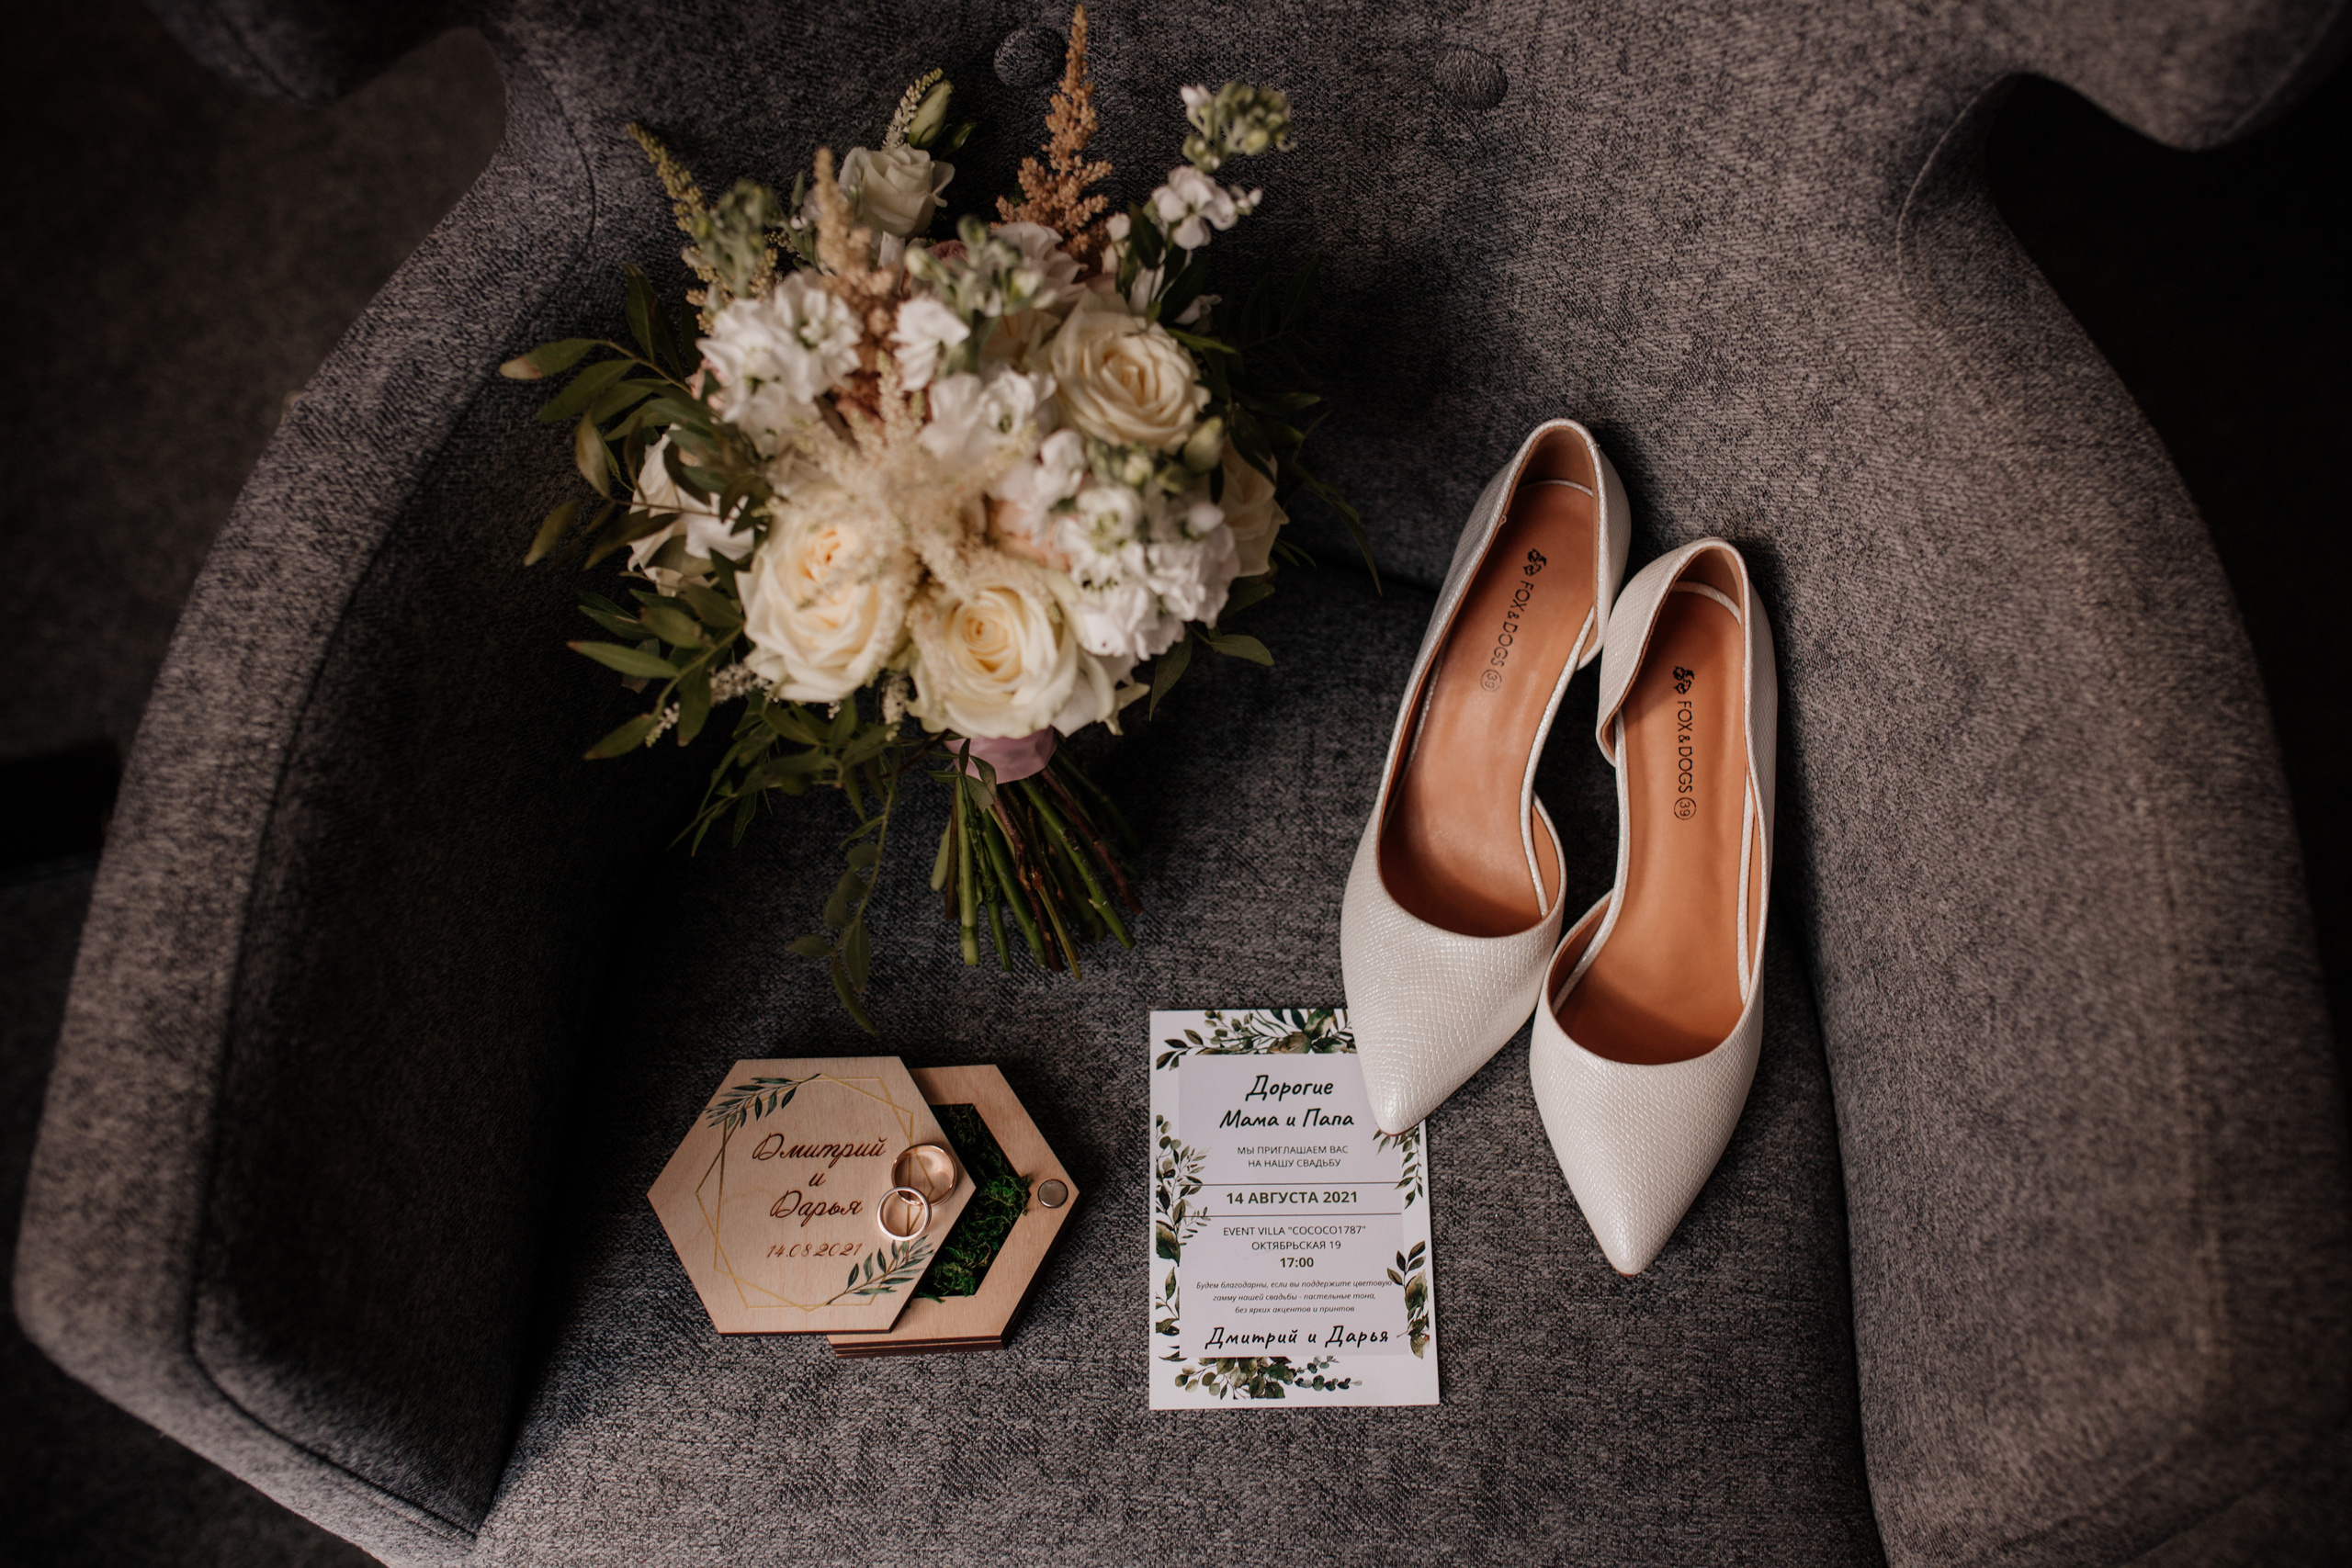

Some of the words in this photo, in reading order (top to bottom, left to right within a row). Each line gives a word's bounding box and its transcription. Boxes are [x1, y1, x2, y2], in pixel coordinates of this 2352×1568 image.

[1245, 1075, 1334, 1101] Дорогие
[1219, 1110, 1279, 1129] Мама
[1286, 1116, 1295, 1126] и
[1302, 1108, 1354, 1128] Папа
[752, 1133, 888, 1168] Дмитрий
[1238, 1146, 1254, 1155] МЫ
[1329, 1145, 1349, 1154] ВАС
[1248, 1159, 1261, 1168] НА
[1264, 1159, 1294, 1168] НАШУ
[1296, 1159, 1341, 1168] СВАДЬБУ
[808, 1173, 826, 1187] и
[1227, 1192, 1244, 1204] 14
[1248, 1191, 1319, 1204] АВГУСТА
[1323, 1190, 1357, 1203] 2021
[769, 1190, 863, 1227] Дарья
[1223, 1227, 1255, 1236] EVENT
[1258, 1227, 1286, 1235] VILLA
[1251, 1241, 1326, 1250] ОКТЯБРЬСКАЯ
[1329, 1240, 1341, 1249] 19
[1280, 1258, 1314, 1268] 17:00
[1196, 1281, 1219, 1291] Будем
[1220, 1280, 1268, 1290] благодарны,
[1302, 1280, 1351, 1289] поддержите
[1213, 1294, 1238, 1303] гамму
[1249, 1306, 1271, 1314] ярких
[1319, 1305, 1355, 1314] принтов
[1204, 1326, 1298, 1349] Дмитрий
[1307, 1333, 1317, 1344] и
[1325, 1325, 1388, 1348] Дарья
